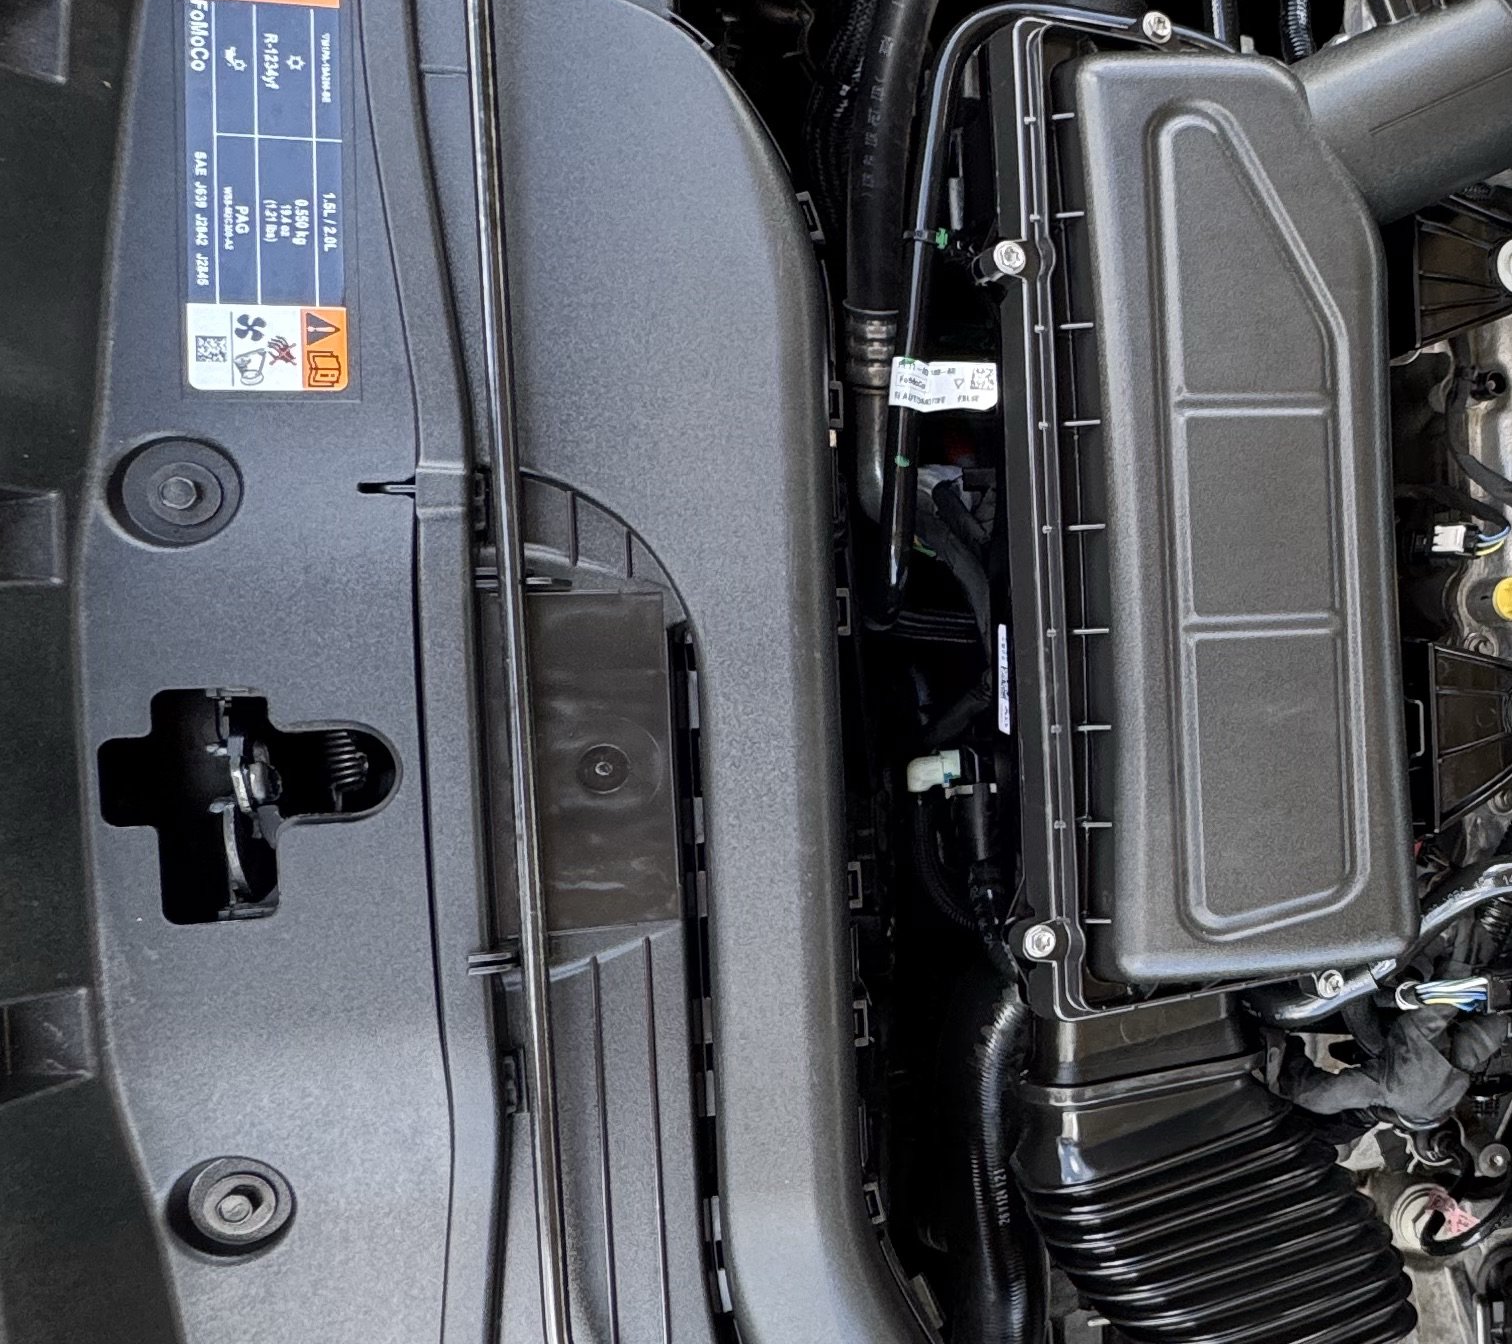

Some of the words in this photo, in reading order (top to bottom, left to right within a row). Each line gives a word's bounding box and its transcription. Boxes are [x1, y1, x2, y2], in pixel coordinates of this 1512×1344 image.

[188, 0, 210, 72] FoMoCo
[261, 32, 280, 90] R-1234yf
[235, 205, 250, 235] PAG
[294, 199, 310, 229] 0.550
[292, 231, 310, 246] kg
[323, 226, 338, 252] 2.0L
